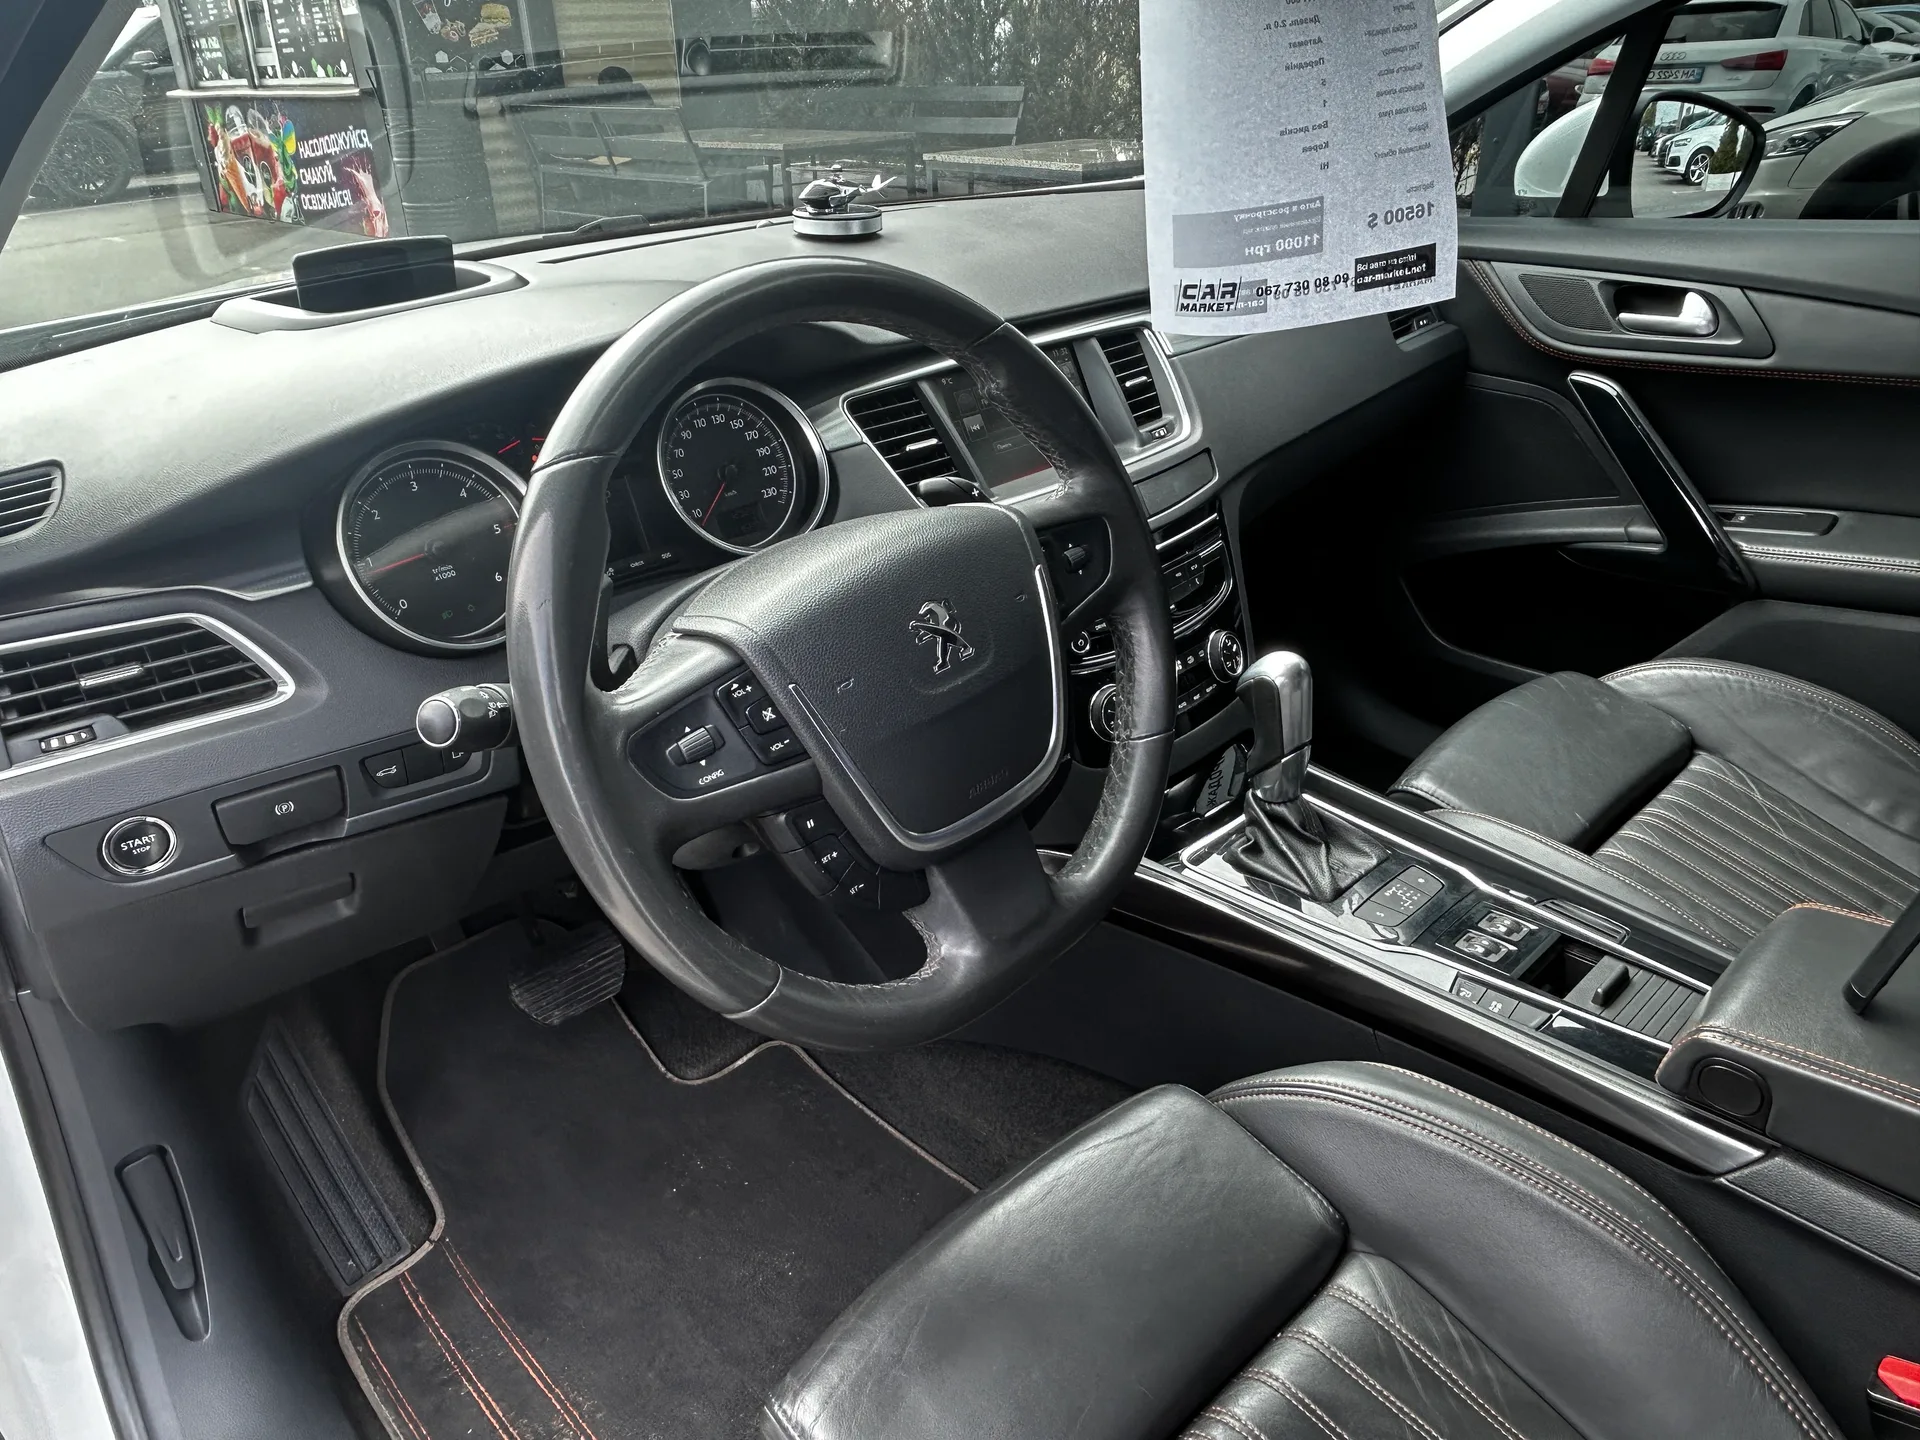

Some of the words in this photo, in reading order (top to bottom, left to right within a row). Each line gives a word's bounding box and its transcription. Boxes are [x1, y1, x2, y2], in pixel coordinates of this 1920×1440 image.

[297, 125, 373, 159] НАСОЛОДЖУЙСЯ,
[299, 160, 337, 185] СМАКУЙ,
[301, 187, 353, 210] ОСВІЖАЙСЯ!
[1182, 281, 1239, 300] CAR
[1255, 284, 1281, 298] 067
[1285, 280, 1310, 294] 730
[1314, 276, 1331, 289] 08
[1334, 273, 1350, 286] 09
[1180, 302, 1234, 313] MARKET
[693, 417, 707, 429] 110
[711, 413, 726, 425] 130
[729, 418, 744, 430] 150
[680, 429, 692, 440] 90
[745, 429, 759, 441] 170
[674, 448, 685, 459] 70
[756, 446, 771, 457] 190
[672, 468, 684, 479] 50
[762, 464, 778, 477] 210
[409, 481, 418, 491] 3
[460, 488, 467, 498] 4
[678, 489, 690, 500] 30
[761, 486, 778, 499] 230
[371, 509, 381, 520] 2
[692, 508, 703, 519] 10
[493, 524, 501, 534] 5
[495, 572, 502, 582] 6
[399, 599, 408, 609] 0
[698, 768, 725, 785] CONFIG
[120, 833, 157, 851] START
[132, 845, 151, 855] STOP
